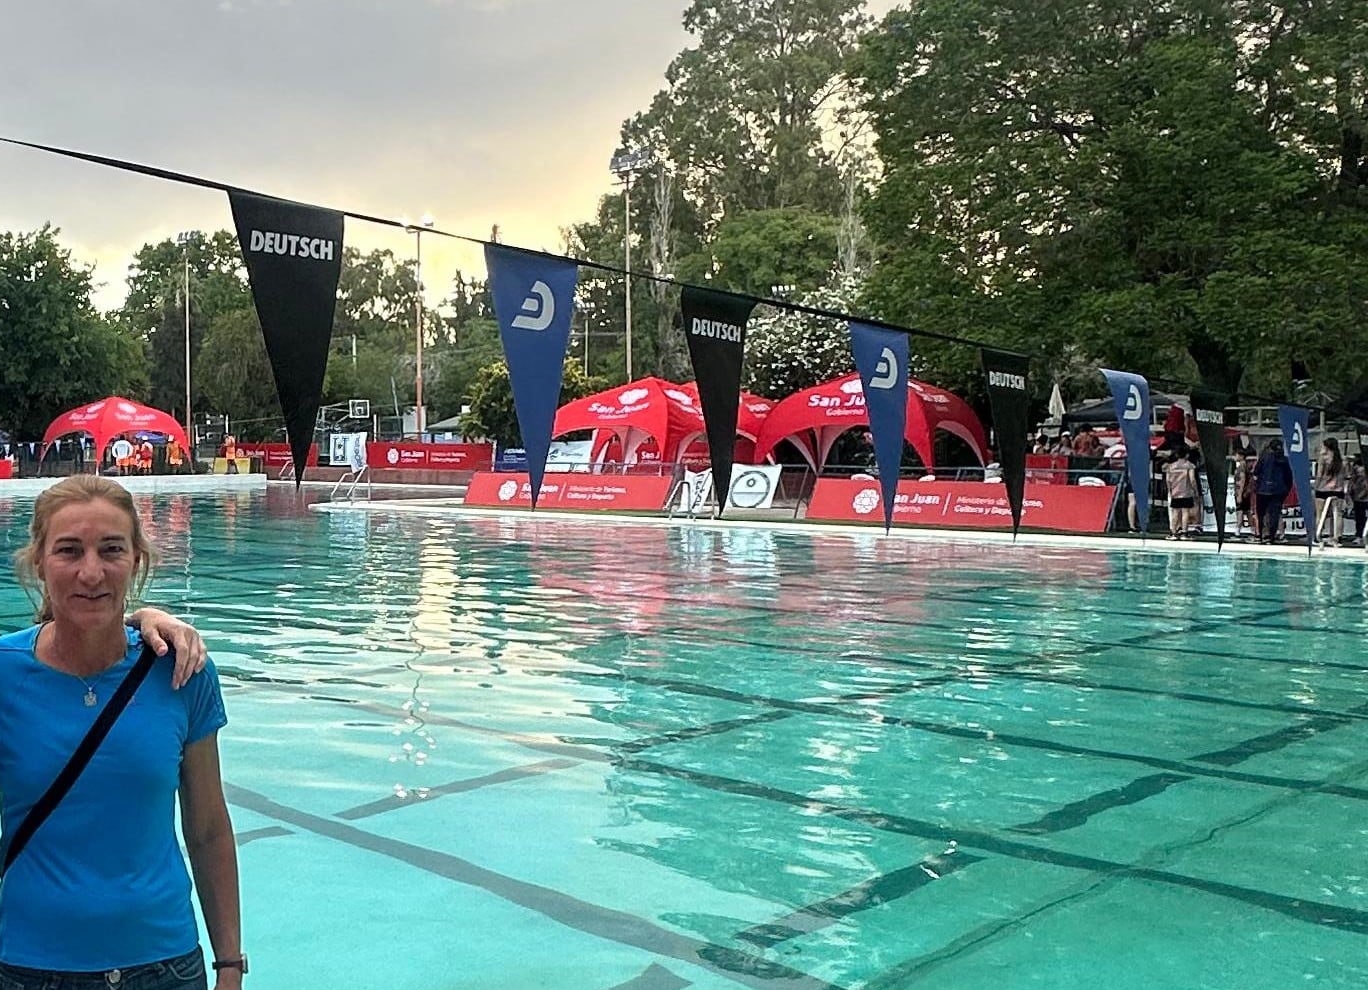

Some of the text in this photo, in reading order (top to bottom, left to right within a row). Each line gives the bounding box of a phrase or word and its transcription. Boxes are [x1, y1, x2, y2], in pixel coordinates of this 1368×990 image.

[249, 228, 334, 261] DEUTSCH
[692, 316, 742, 343] DEUTSCH
[989, 370, 1026, 391] DEUTSCH
[588, 401, 615, 415] San
[808, 394, 866, 408] San Ju
[910, 493, 940, 505] Juan
